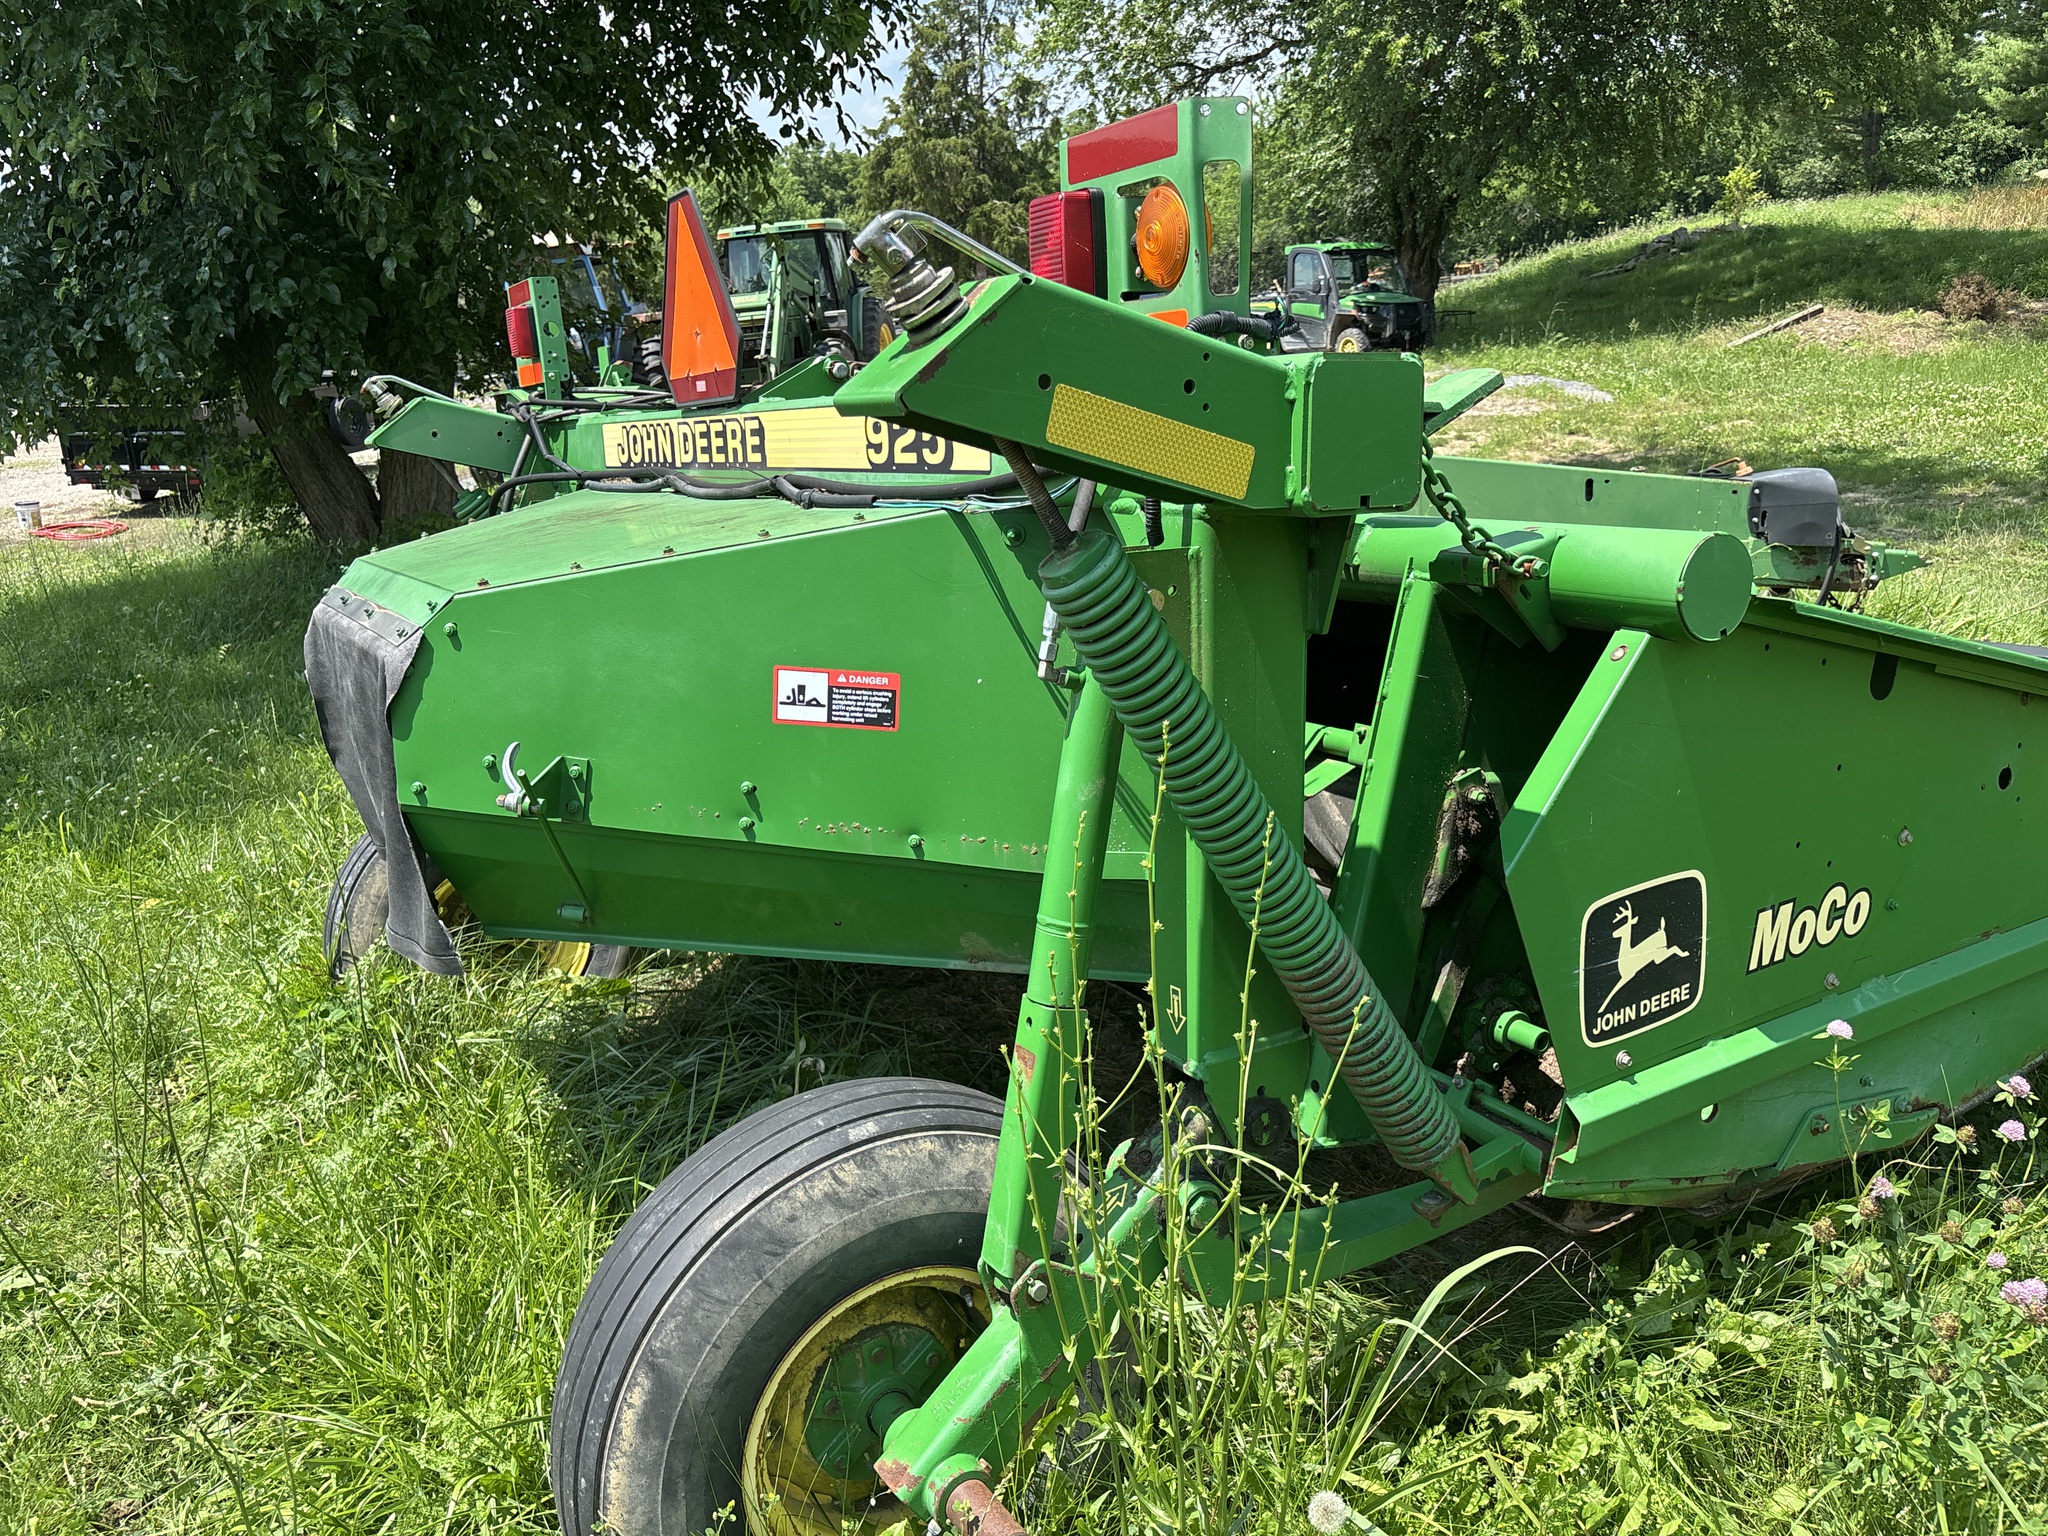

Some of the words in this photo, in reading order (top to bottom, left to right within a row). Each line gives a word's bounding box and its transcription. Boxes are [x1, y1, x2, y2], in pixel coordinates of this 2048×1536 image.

[617, 424, 673, 465] JOHN
[679, 418, 763, 464] DEERE
[866, 417, 947, 465] 925
[848, 675, 889, 686] DANGER
[1746, 883, 1872, 974] MoCo
[1592, 1004, 1637, 1036] JOHN
[1639, 982, 1691, 1017] DEERE
